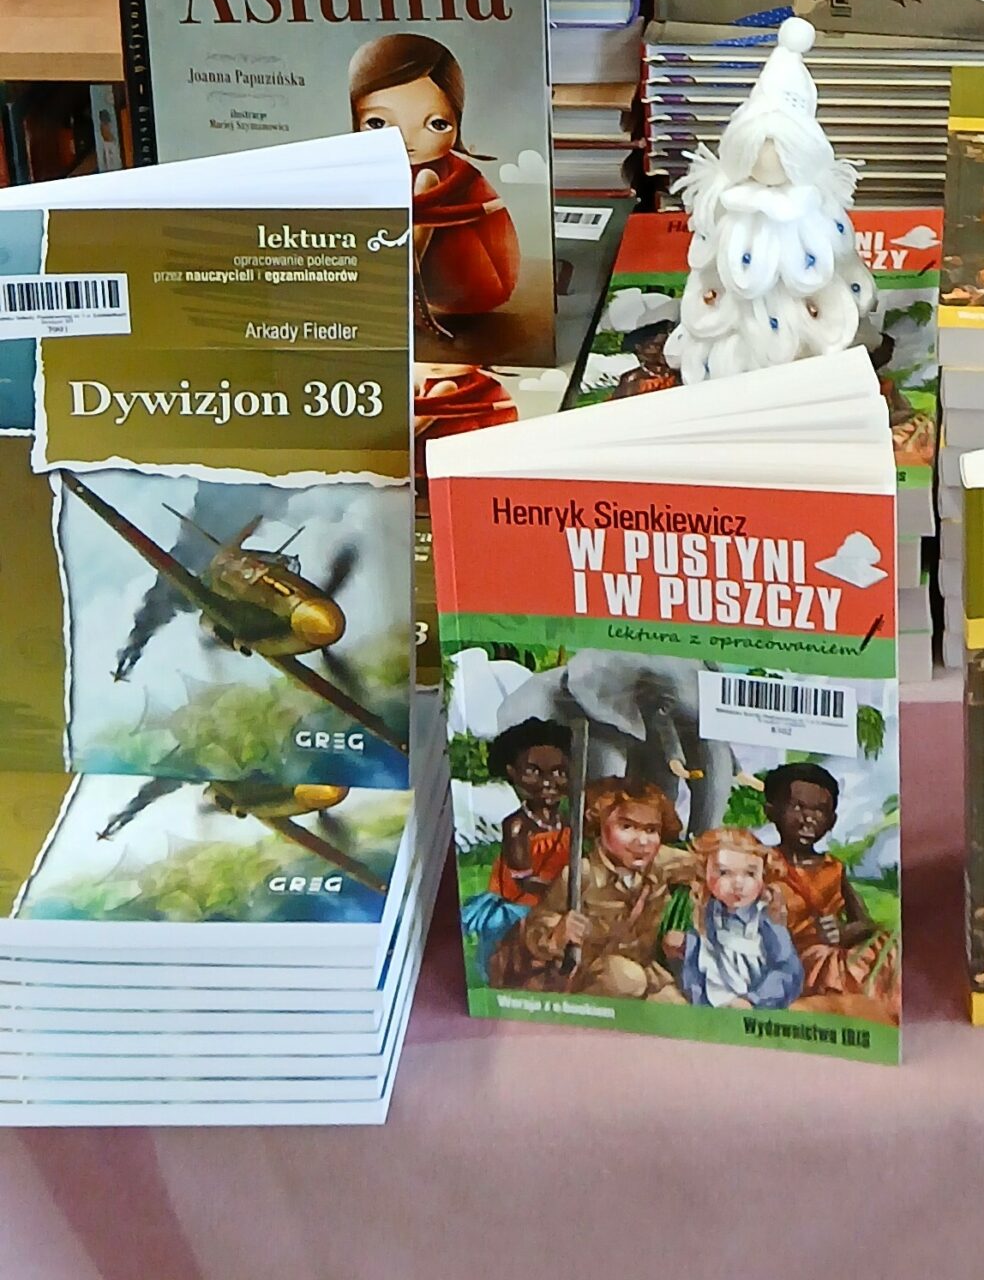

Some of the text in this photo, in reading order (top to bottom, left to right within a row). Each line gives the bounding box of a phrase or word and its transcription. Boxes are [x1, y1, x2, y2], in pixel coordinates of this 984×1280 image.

[188, 68, 306, 88] Joanna Papuzińska
[257, 224, 357, 249] lektura
[233, 255, 357, 269] opracowanie polecane
[153, 270, 182, 283] przez
[186, 269, 254, 283] nauczycieli
[265, 269, 358, 283] egzaminatorów
[245, 321, 358, 342] Arkady Fiedler
[69, 379, 384, 425] Dywizjon 303
[493, 497, 747, 536] Henryk Sienkiewicz
[566, 527, 806, 583] W PUSTYNI
[573, 572, 842, 632] I W PUSZCZY
[608, 624, 861, 656] lektura z opracowaniem
[295, 730, 365, 751] GREG
[269, 876, 343, 893] GREG
